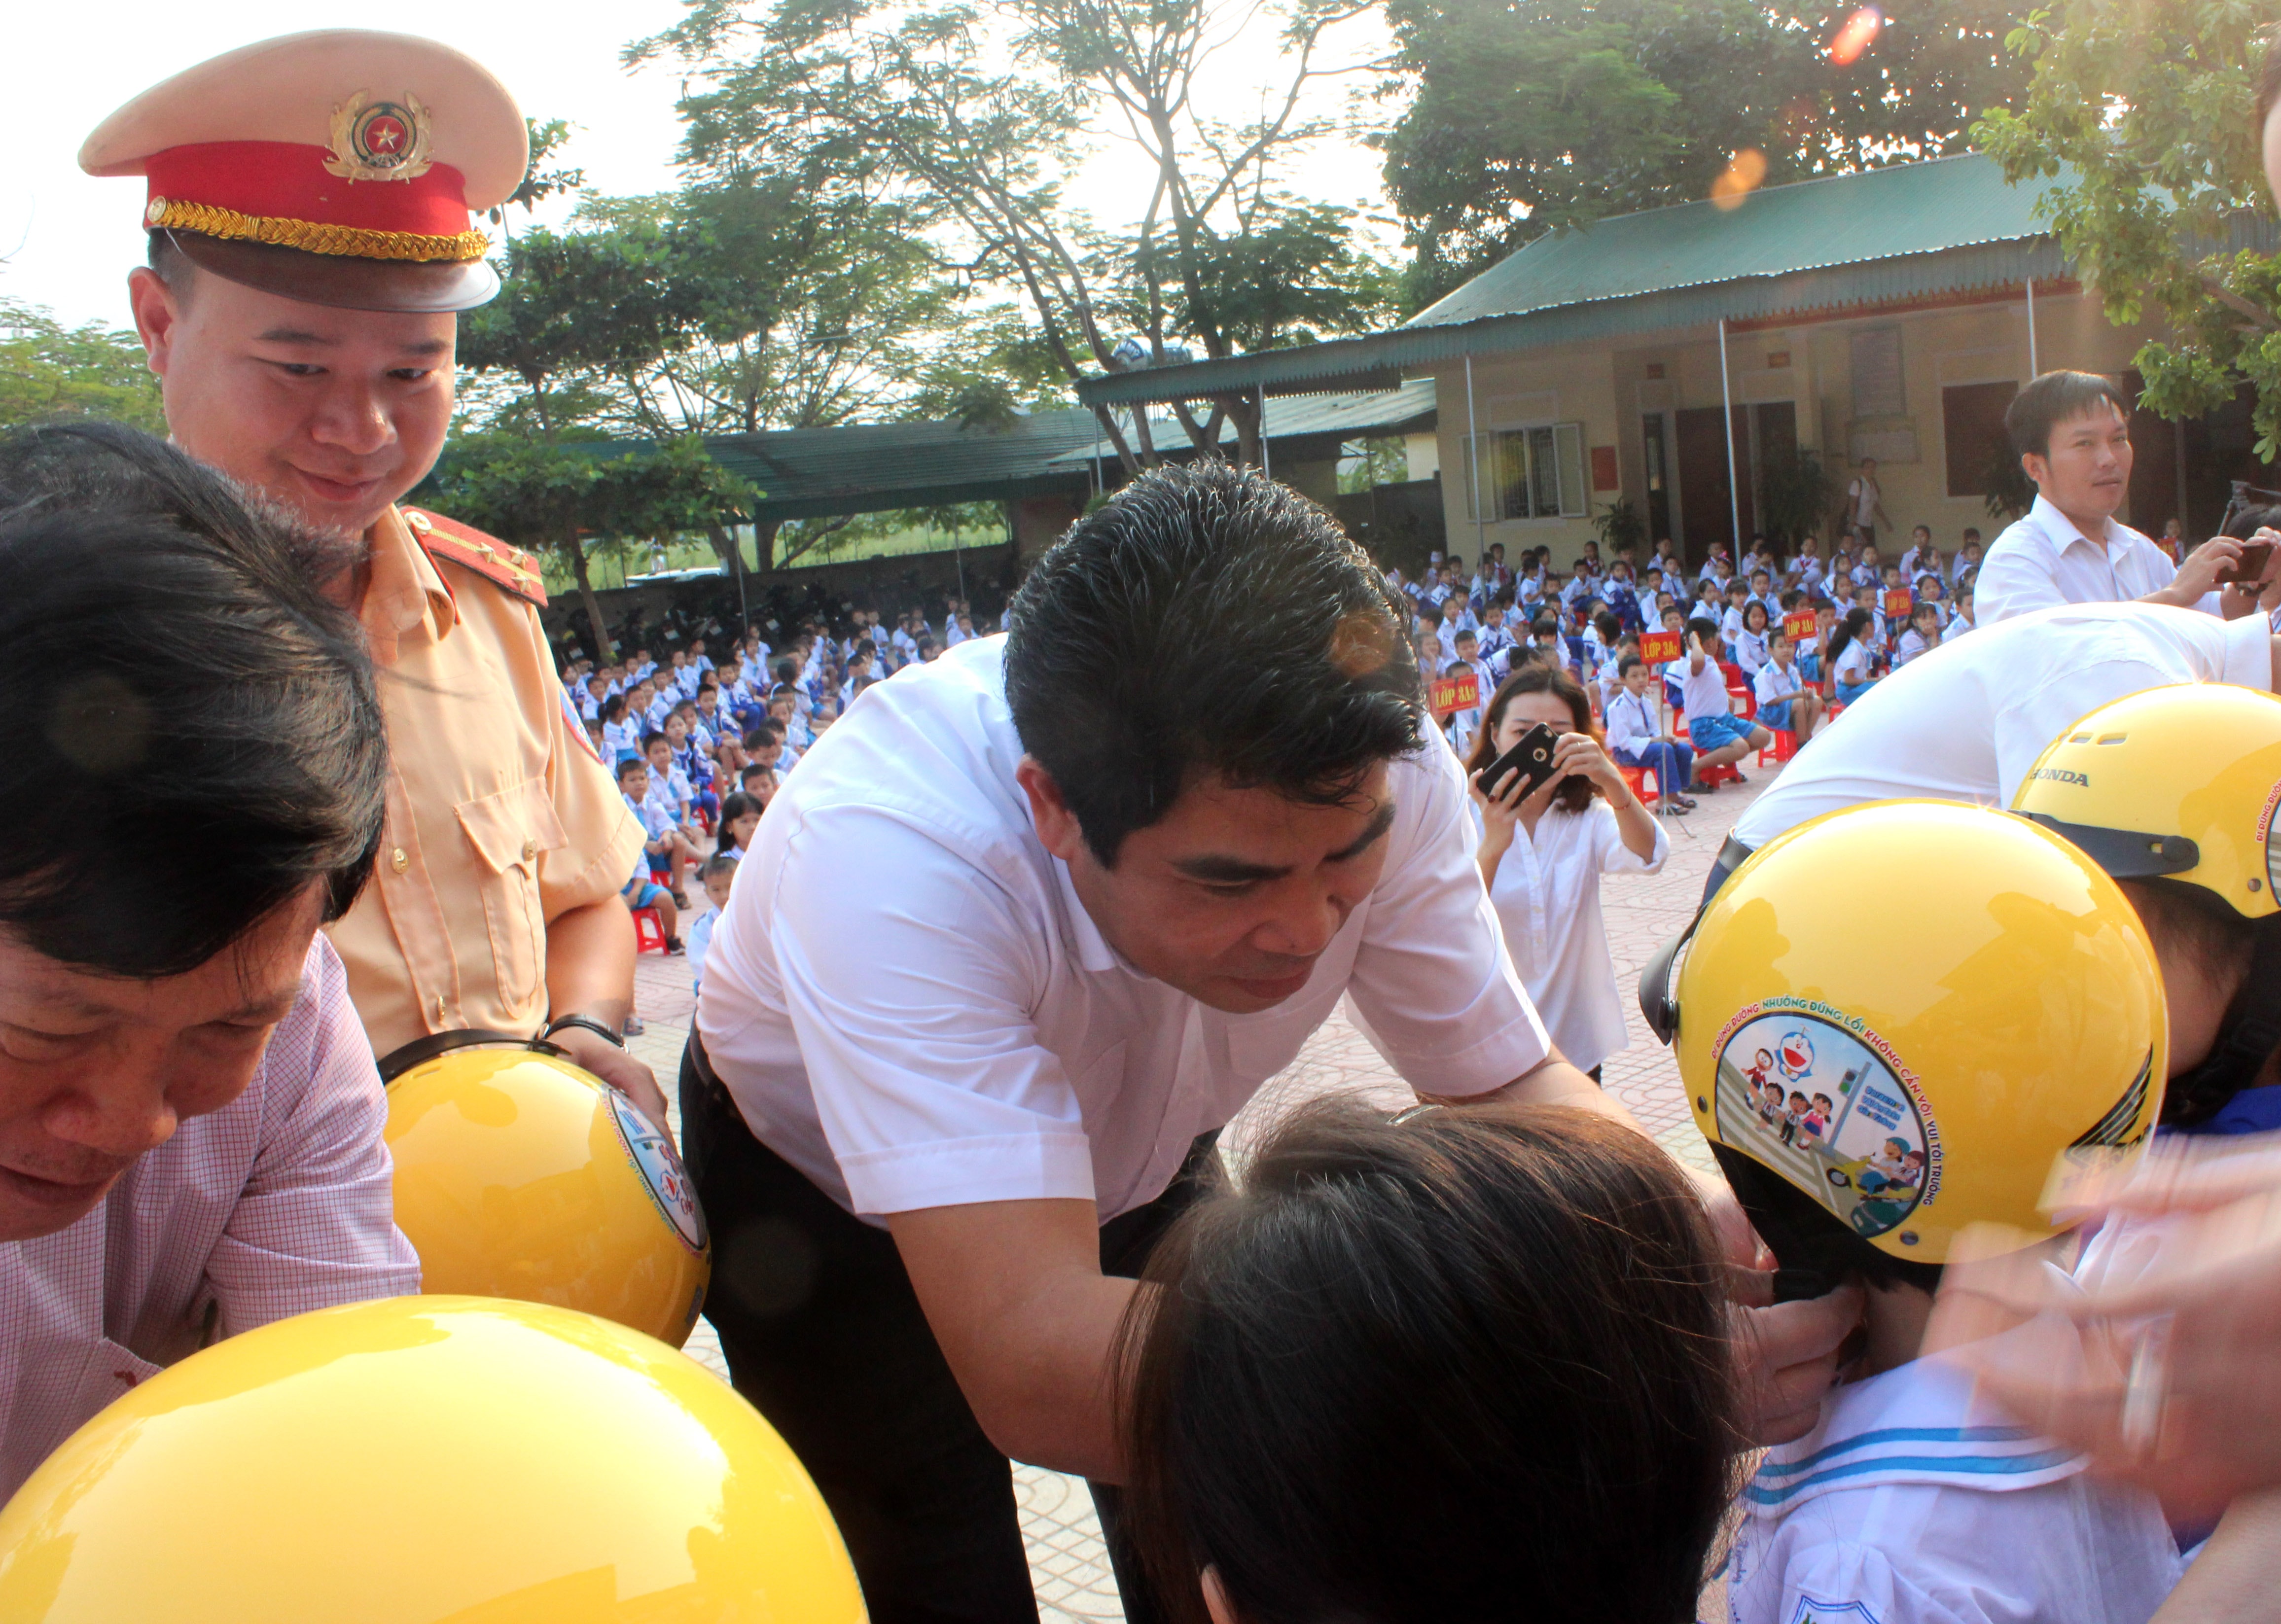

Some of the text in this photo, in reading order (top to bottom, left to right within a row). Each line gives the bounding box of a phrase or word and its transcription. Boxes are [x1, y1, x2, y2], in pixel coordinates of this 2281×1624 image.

[1644, 638, 1661, 658] LỚP
[1435, 686, 1455, 708] LỚP
[2029, 769, 2089, 787] HONDA
[1809, 1001, 1842, 1020] ĐÚNG
[1844, 1017, 1865, 1032] LỐI
[1864, 1029, 1902, 1067] KHÔNG
[1926, 1121, 1939, 1139] VUI
